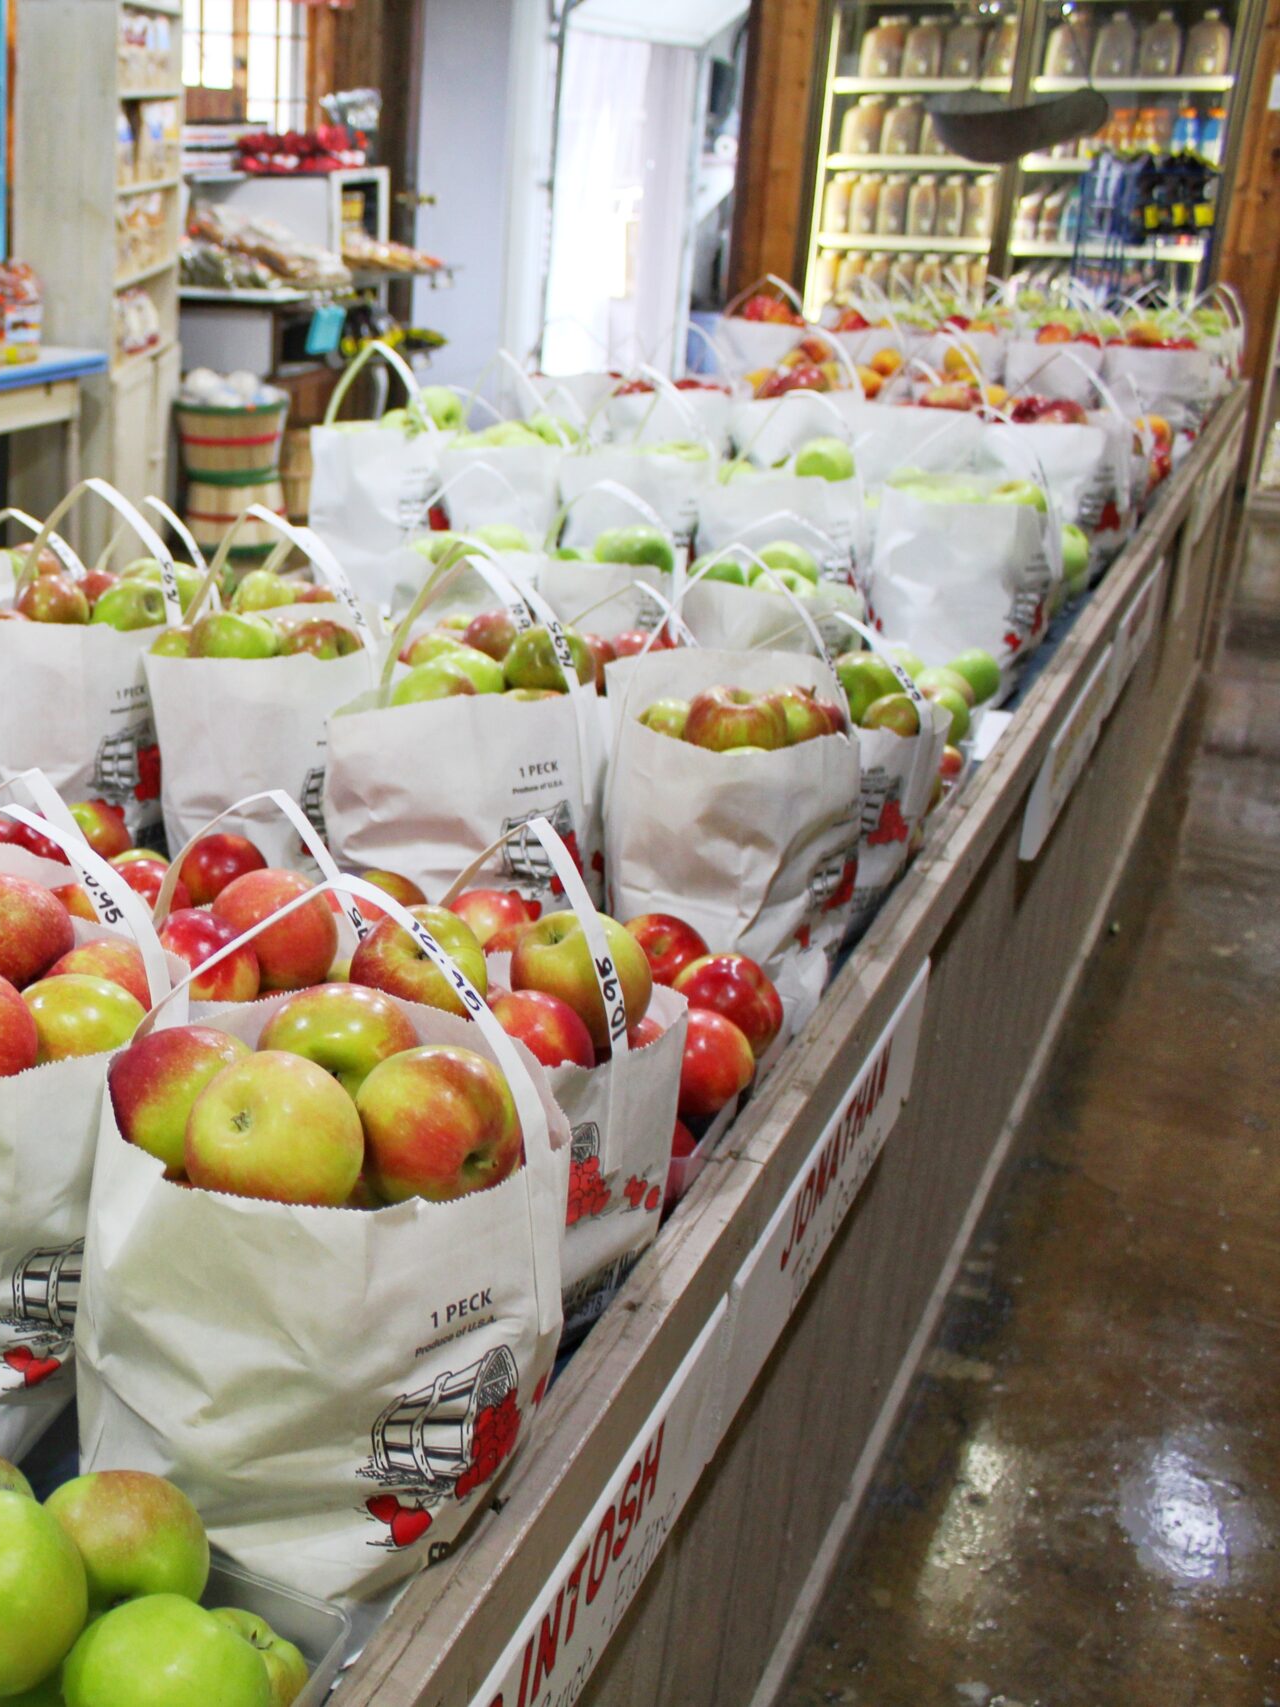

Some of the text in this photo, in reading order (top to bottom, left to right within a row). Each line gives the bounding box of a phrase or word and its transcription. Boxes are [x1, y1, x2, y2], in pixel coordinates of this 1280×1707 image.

[528, 760, 559, 777] PECK
[594, 956, 627, 1042] 10.95
[430, 1287, 493, 1329] 1 PECK
[488, 1418, 666, 1707] INTOSH
